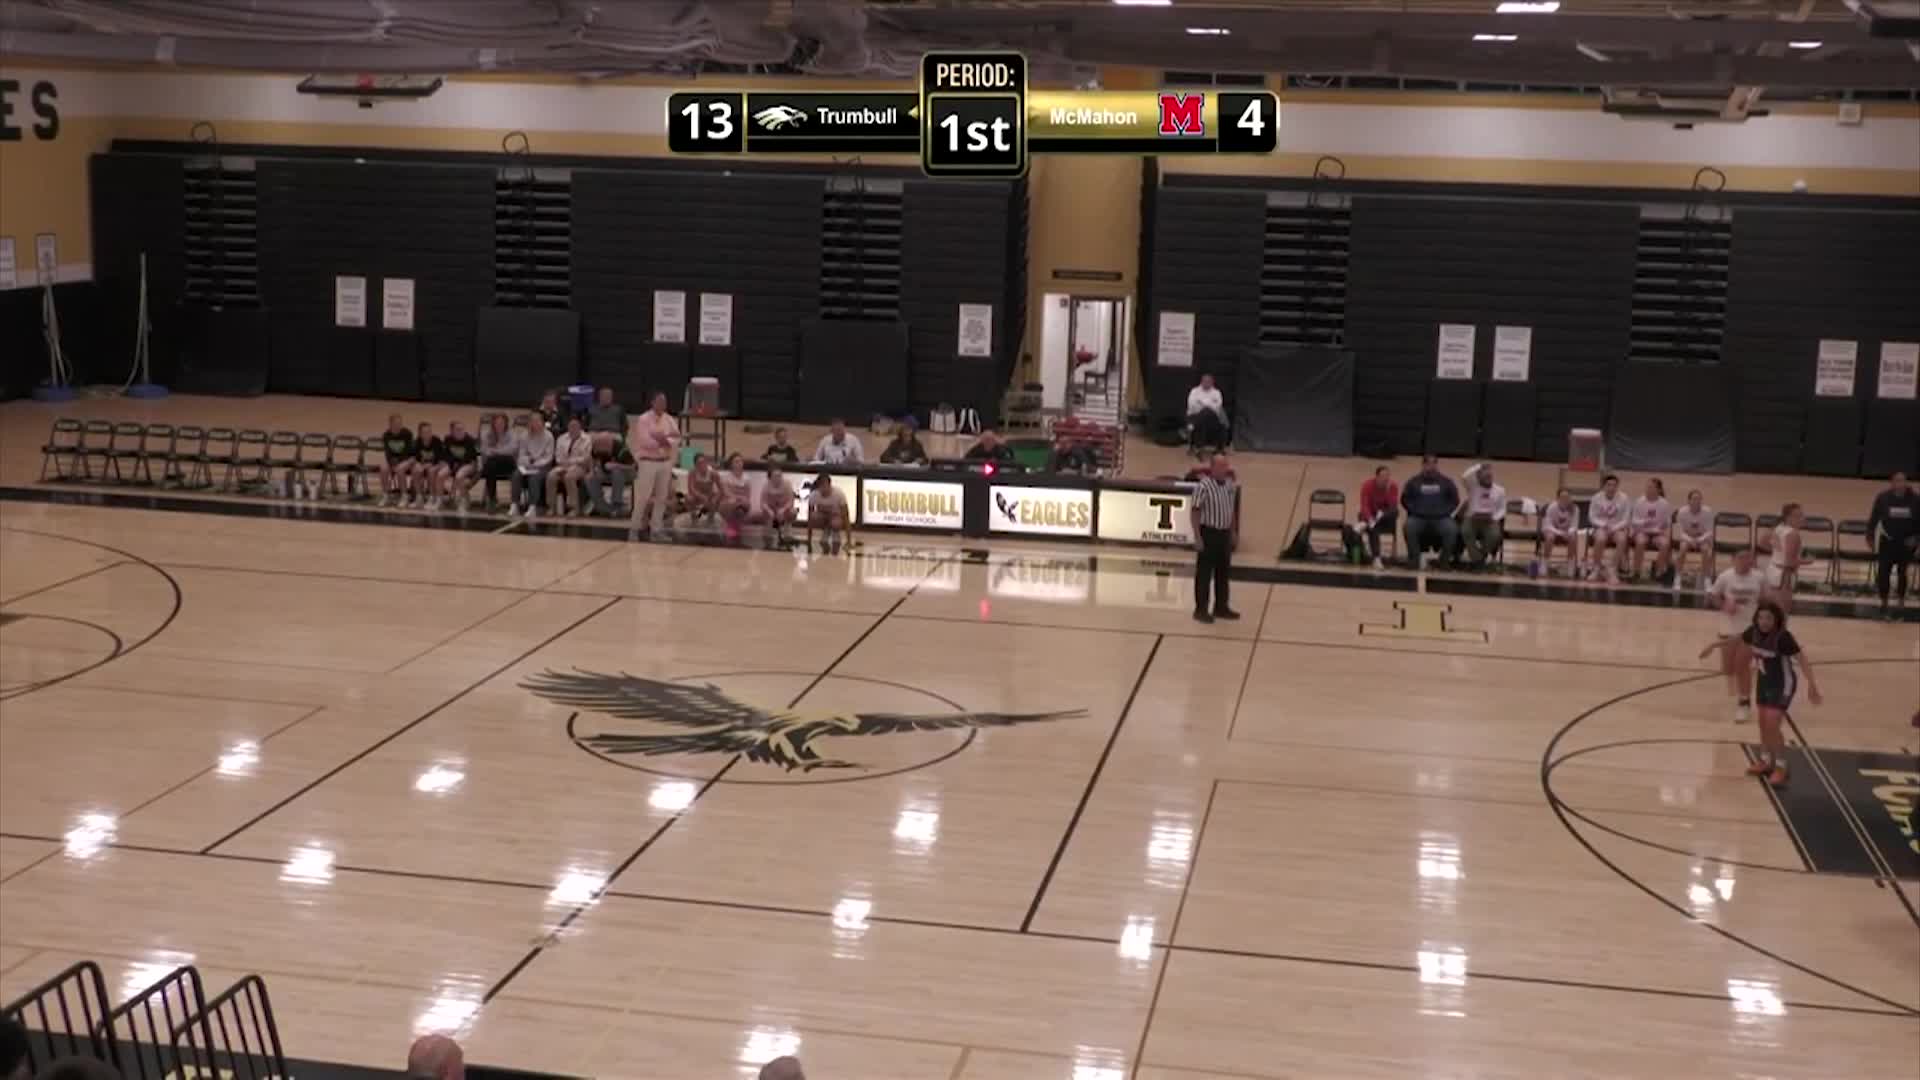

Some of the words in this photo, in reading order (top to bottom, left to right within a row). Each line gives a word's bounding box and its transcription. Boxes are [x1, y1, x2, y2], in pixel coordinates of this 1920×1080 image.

[865, 489, 960, 517] TRUMBULL
[1020, 499, 1089, 528] EAGLES
[1148, 496, 1184, 531] T
[905, 516, 937, 525] SCHOOL
[1141, 531, 1188, 543] ATHLETICS
